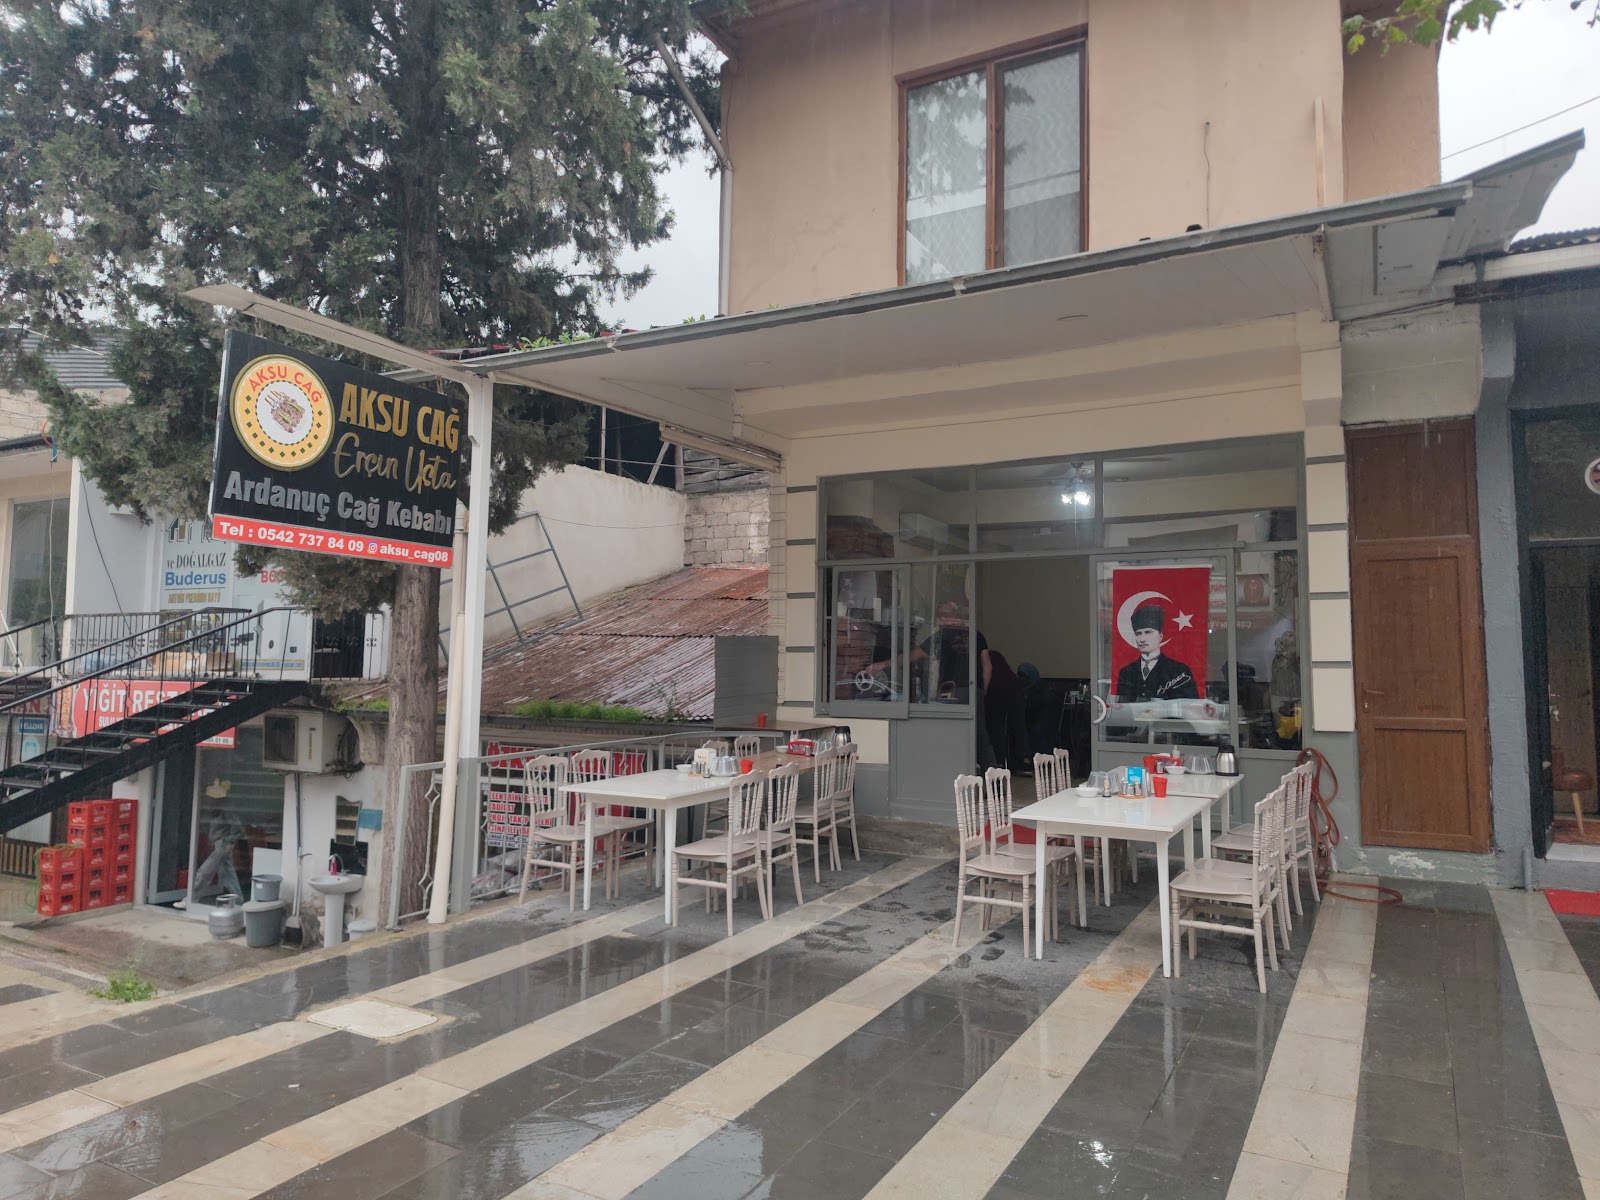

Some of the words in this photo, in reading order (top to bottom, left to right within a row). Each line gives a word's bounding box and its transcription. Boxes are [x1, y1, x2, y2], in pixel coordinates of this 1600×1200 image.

[248, 365, 288, 392] AKSU
[293, 371, 323, 404] CAĞ
[338, 382, 410, 437] AKSU
[417, 405, 460, 453] CAĞ
[405, 445, 457, 495] Usta
[223, 470, 331, 522] Ardanuç
[337, 491, 380, 529] Cağ
[386, 501, 451, 535] Kebabı
[176, 551, 227, 569] DOĞALGAZ
[219, 521, 244, 537] Tel
[257, 527, 294, 546] 0542
[298, 532, 323, 548] 737
[327, 535, 344, 550] 84
[347, 537, 364, 553] 09
[379, 543, 449, 563] aksu_cag08
[165, 571, 227, 586] Buderus
[83, 682, 127, 713] YİĞİT
